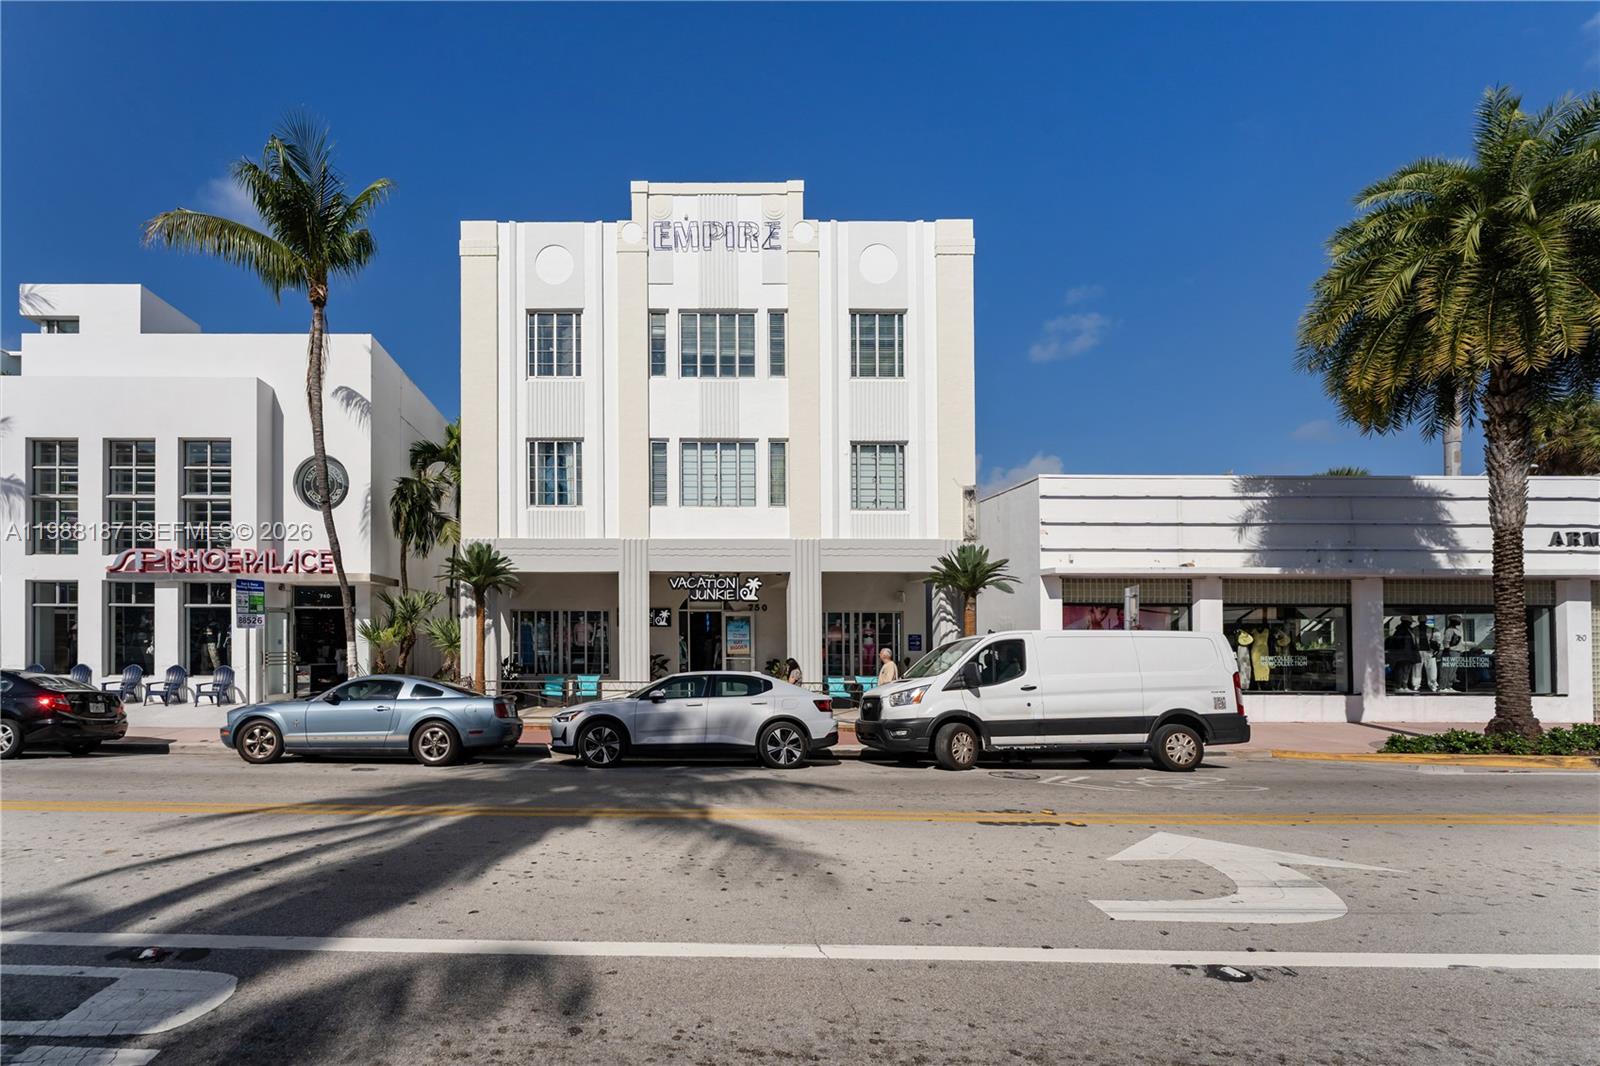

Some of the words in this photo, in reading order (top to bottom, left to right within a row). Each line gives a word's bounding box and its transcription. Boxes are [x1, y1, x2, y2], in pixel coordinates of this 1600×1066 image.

[653, 220, 782, 253] EMPIRE
[669, 577, 736, 589] VACATION
[690, 588, 735, 600] JUNKIE
[749, 604, 767, 612] 750
[238, 616, 263, 624] 88526
[1575, 634, 1587, 642] 760
